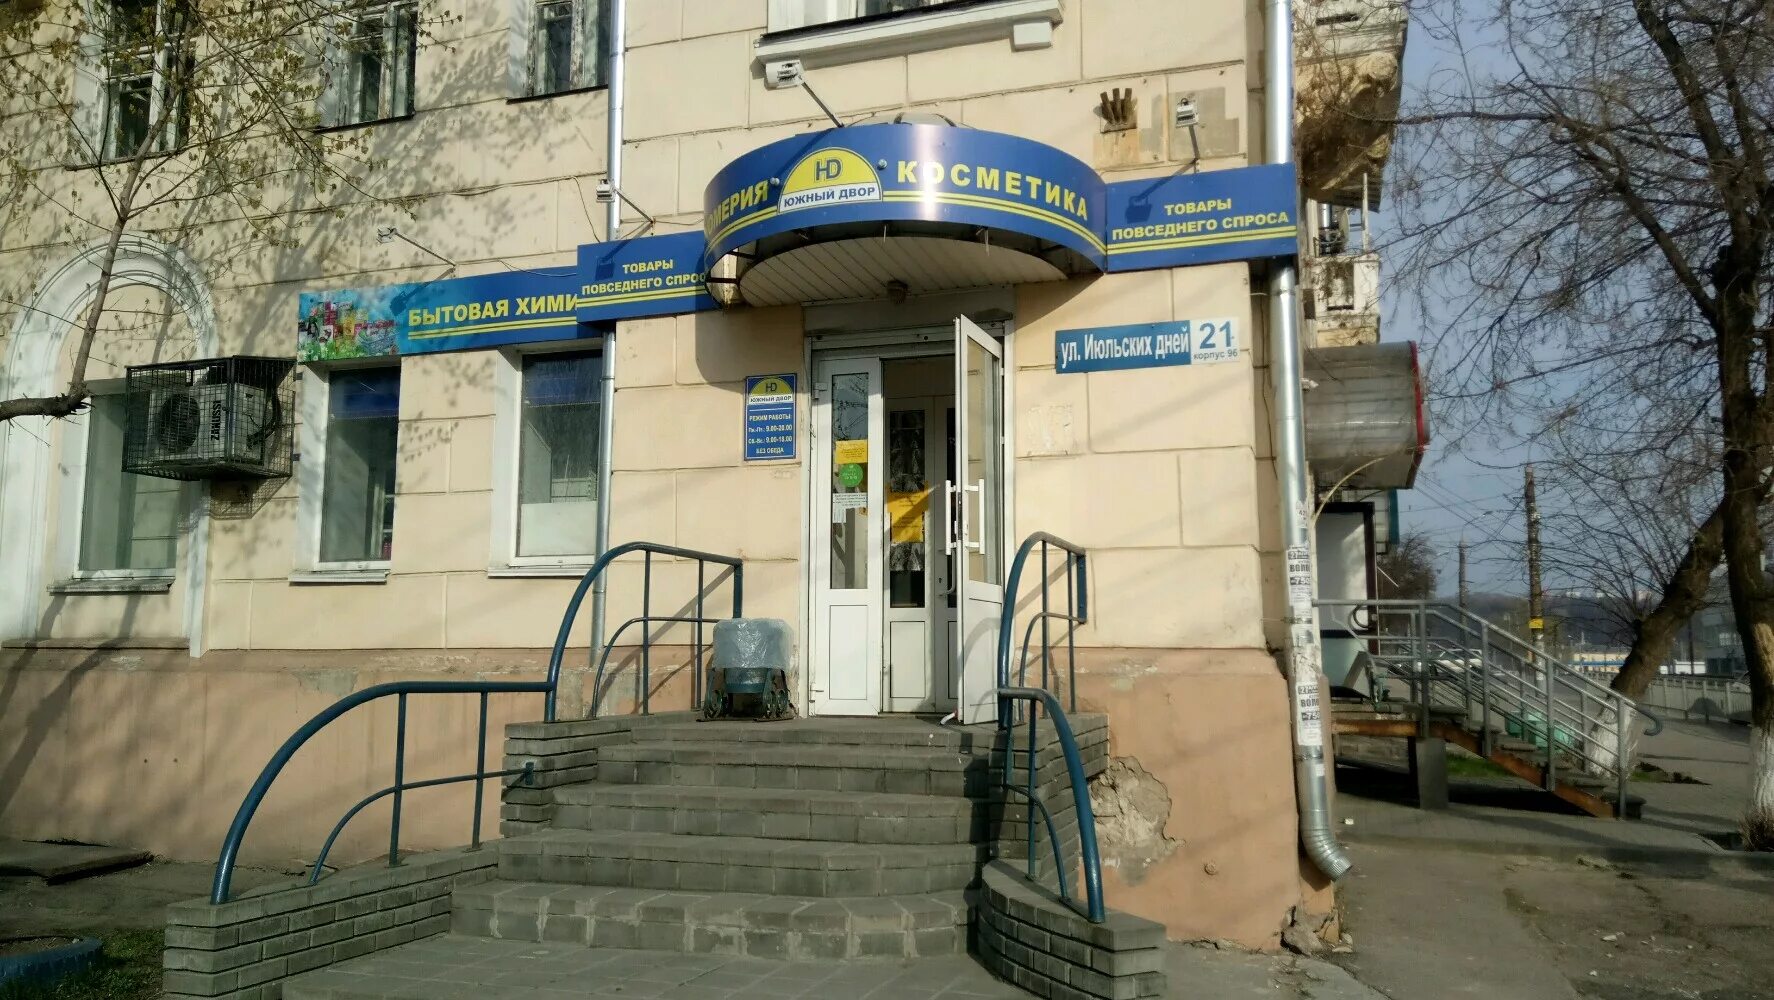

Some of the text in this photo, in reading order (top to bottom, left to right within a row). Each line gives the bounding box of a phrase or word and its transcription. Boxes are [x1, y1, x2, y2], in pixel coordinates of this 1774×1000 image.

[784, 186, 876, 208] ЮЖНЫЙ ДВОР
[897, 160, 1088, 221] КОСМЕТИКА
[1164, 198, 1232, 216] ТОВАРЫ
[1112, 211, 1290, 240] ПОВСЕДНЕГО СПРОСА
[622, 258, 674, 274] ТОВАРЫ
[582, 277, 662, 295] ПОВСЕДНЕГО
[408, 299, 509, 327] БЫТОВАЯ
[1199, 320, 1233, 350] 21
[1061, 326, 1190, 369] ул. Июльских дней
[1193, 348, 1238, 361] корпус 96
[768, 413, 791, 421] РАБОТЫ
